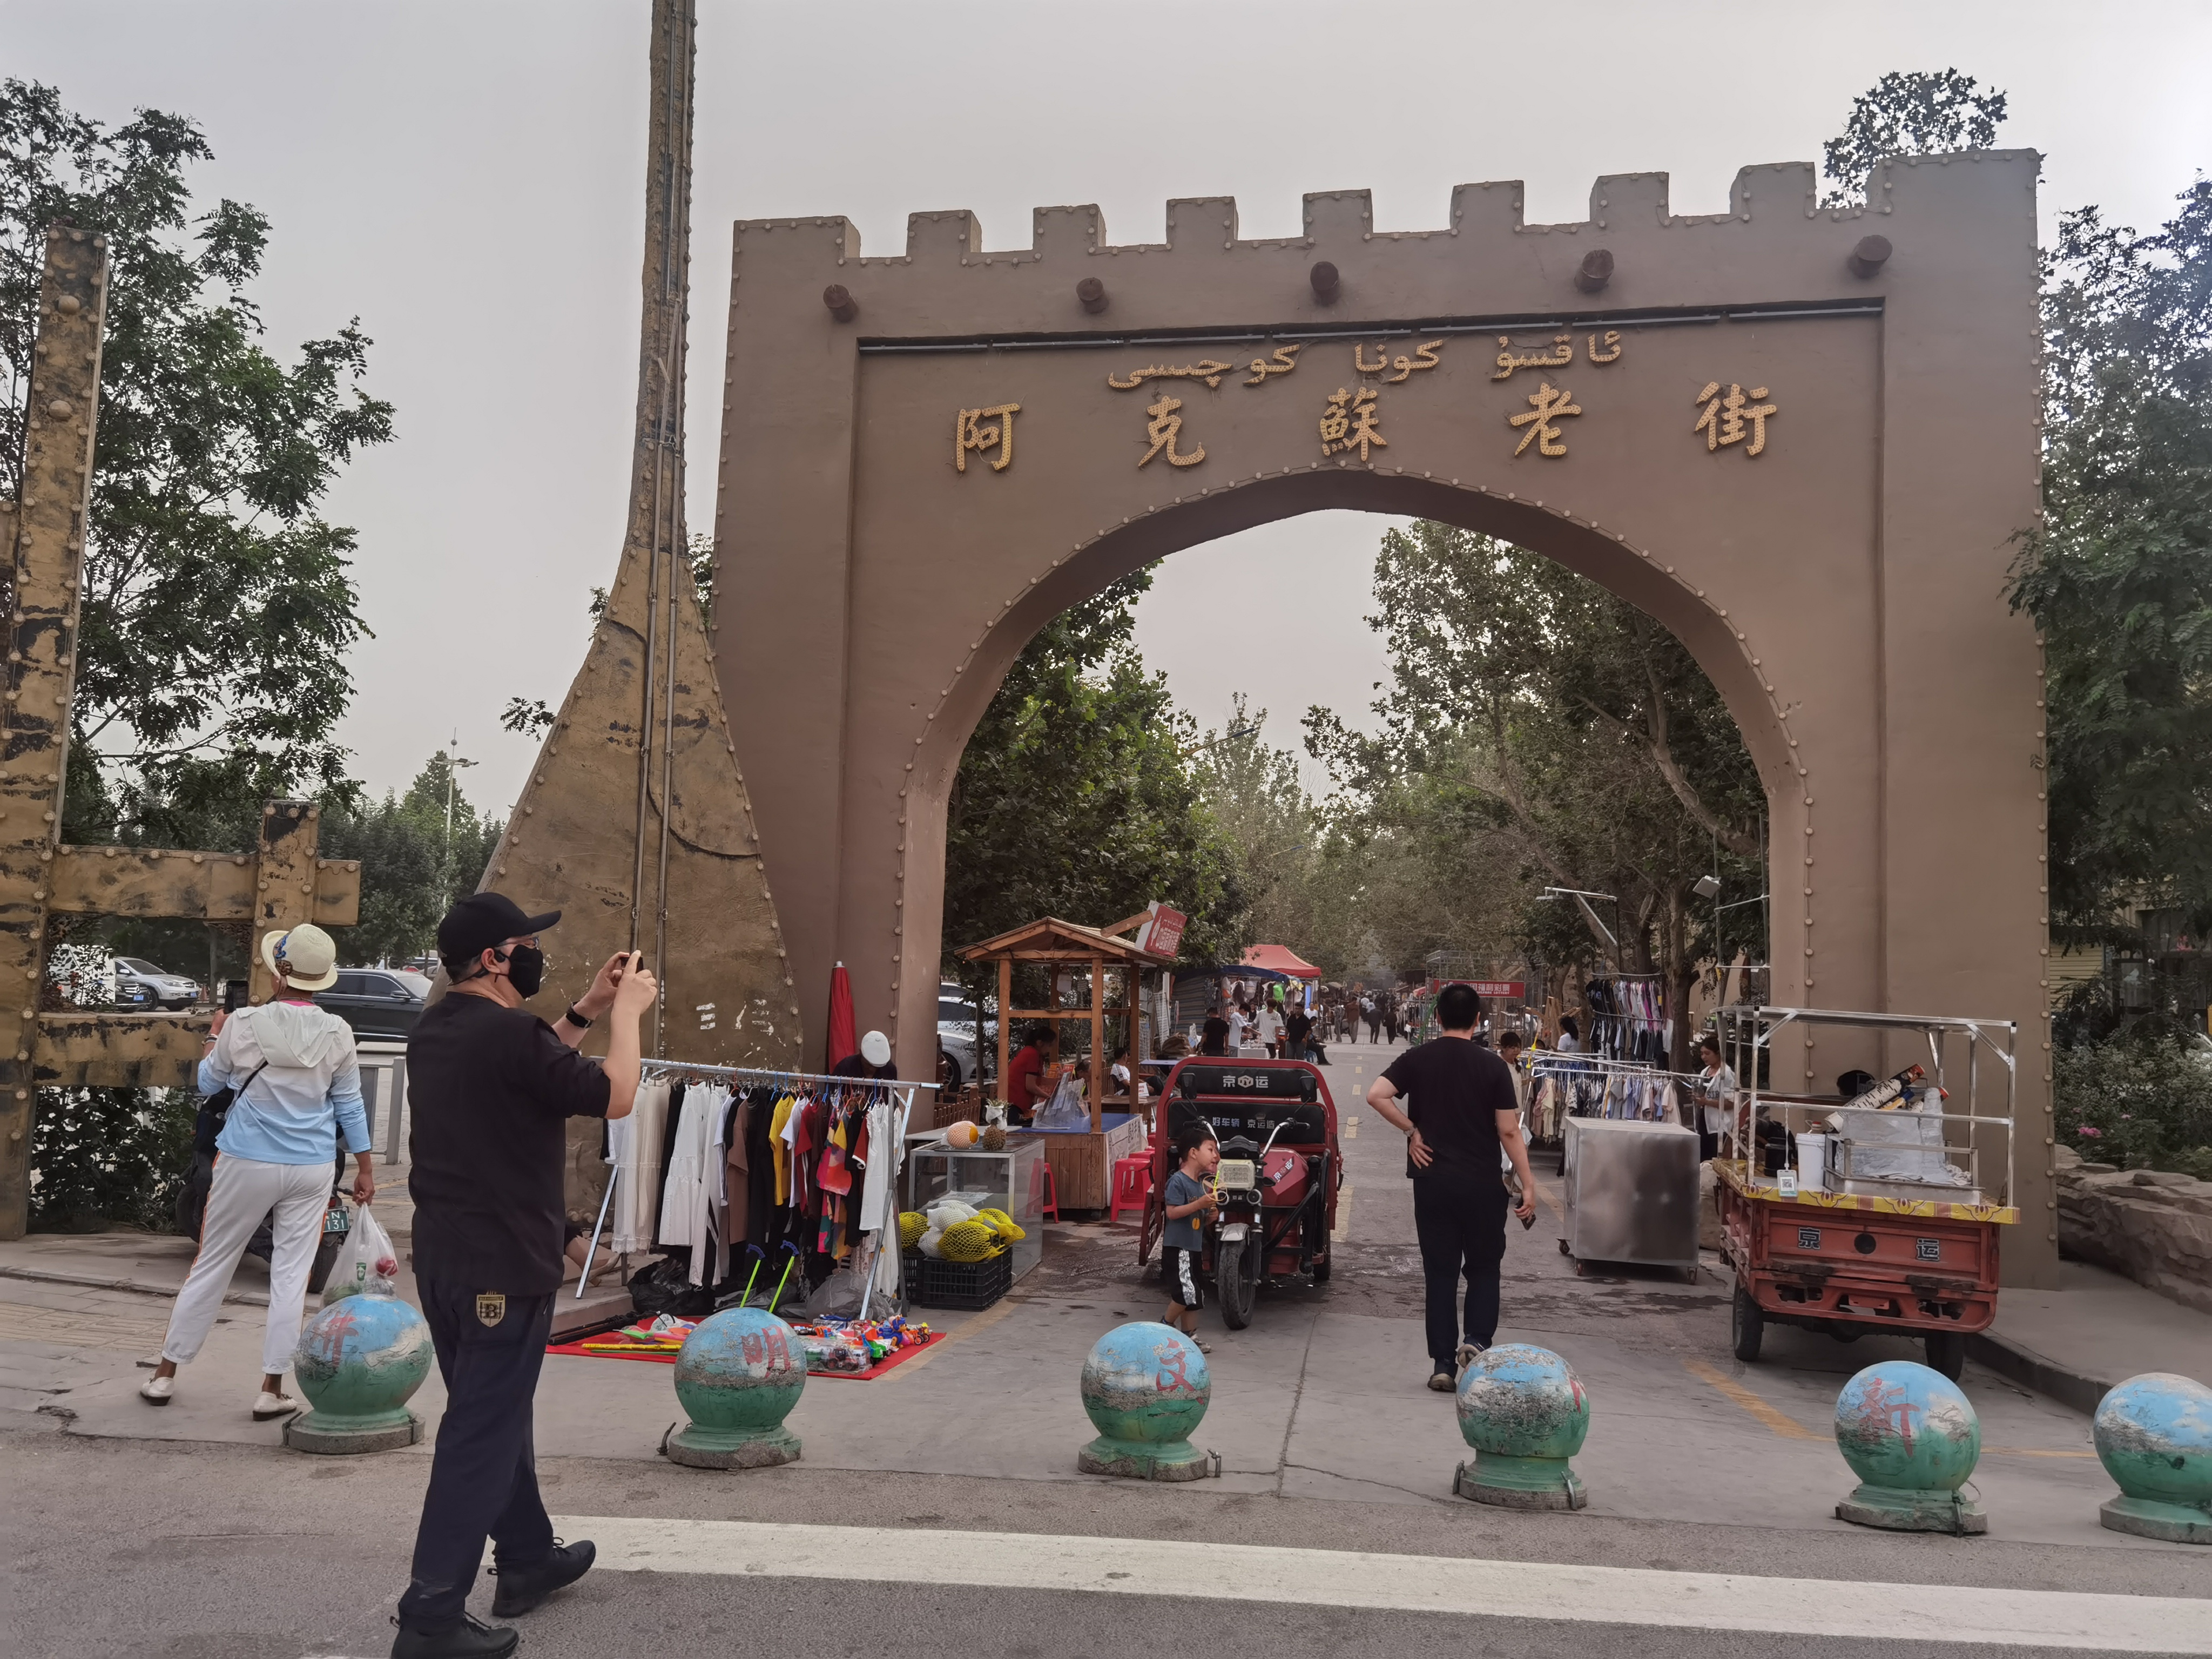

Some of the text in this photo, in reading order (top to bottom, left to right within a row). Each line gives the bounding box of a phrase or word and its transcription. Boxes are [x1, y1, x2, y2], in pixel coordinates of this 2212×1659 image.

[1354, 339, 1443, 381] كونا
[1464, 982, 1510, 992] 国福利彩票
[1212, 1117, 1275, 1129] 好车辆 京运造
[327, 1219, 345, 1230] 131
[740, 1324, 791, 1379] 明
